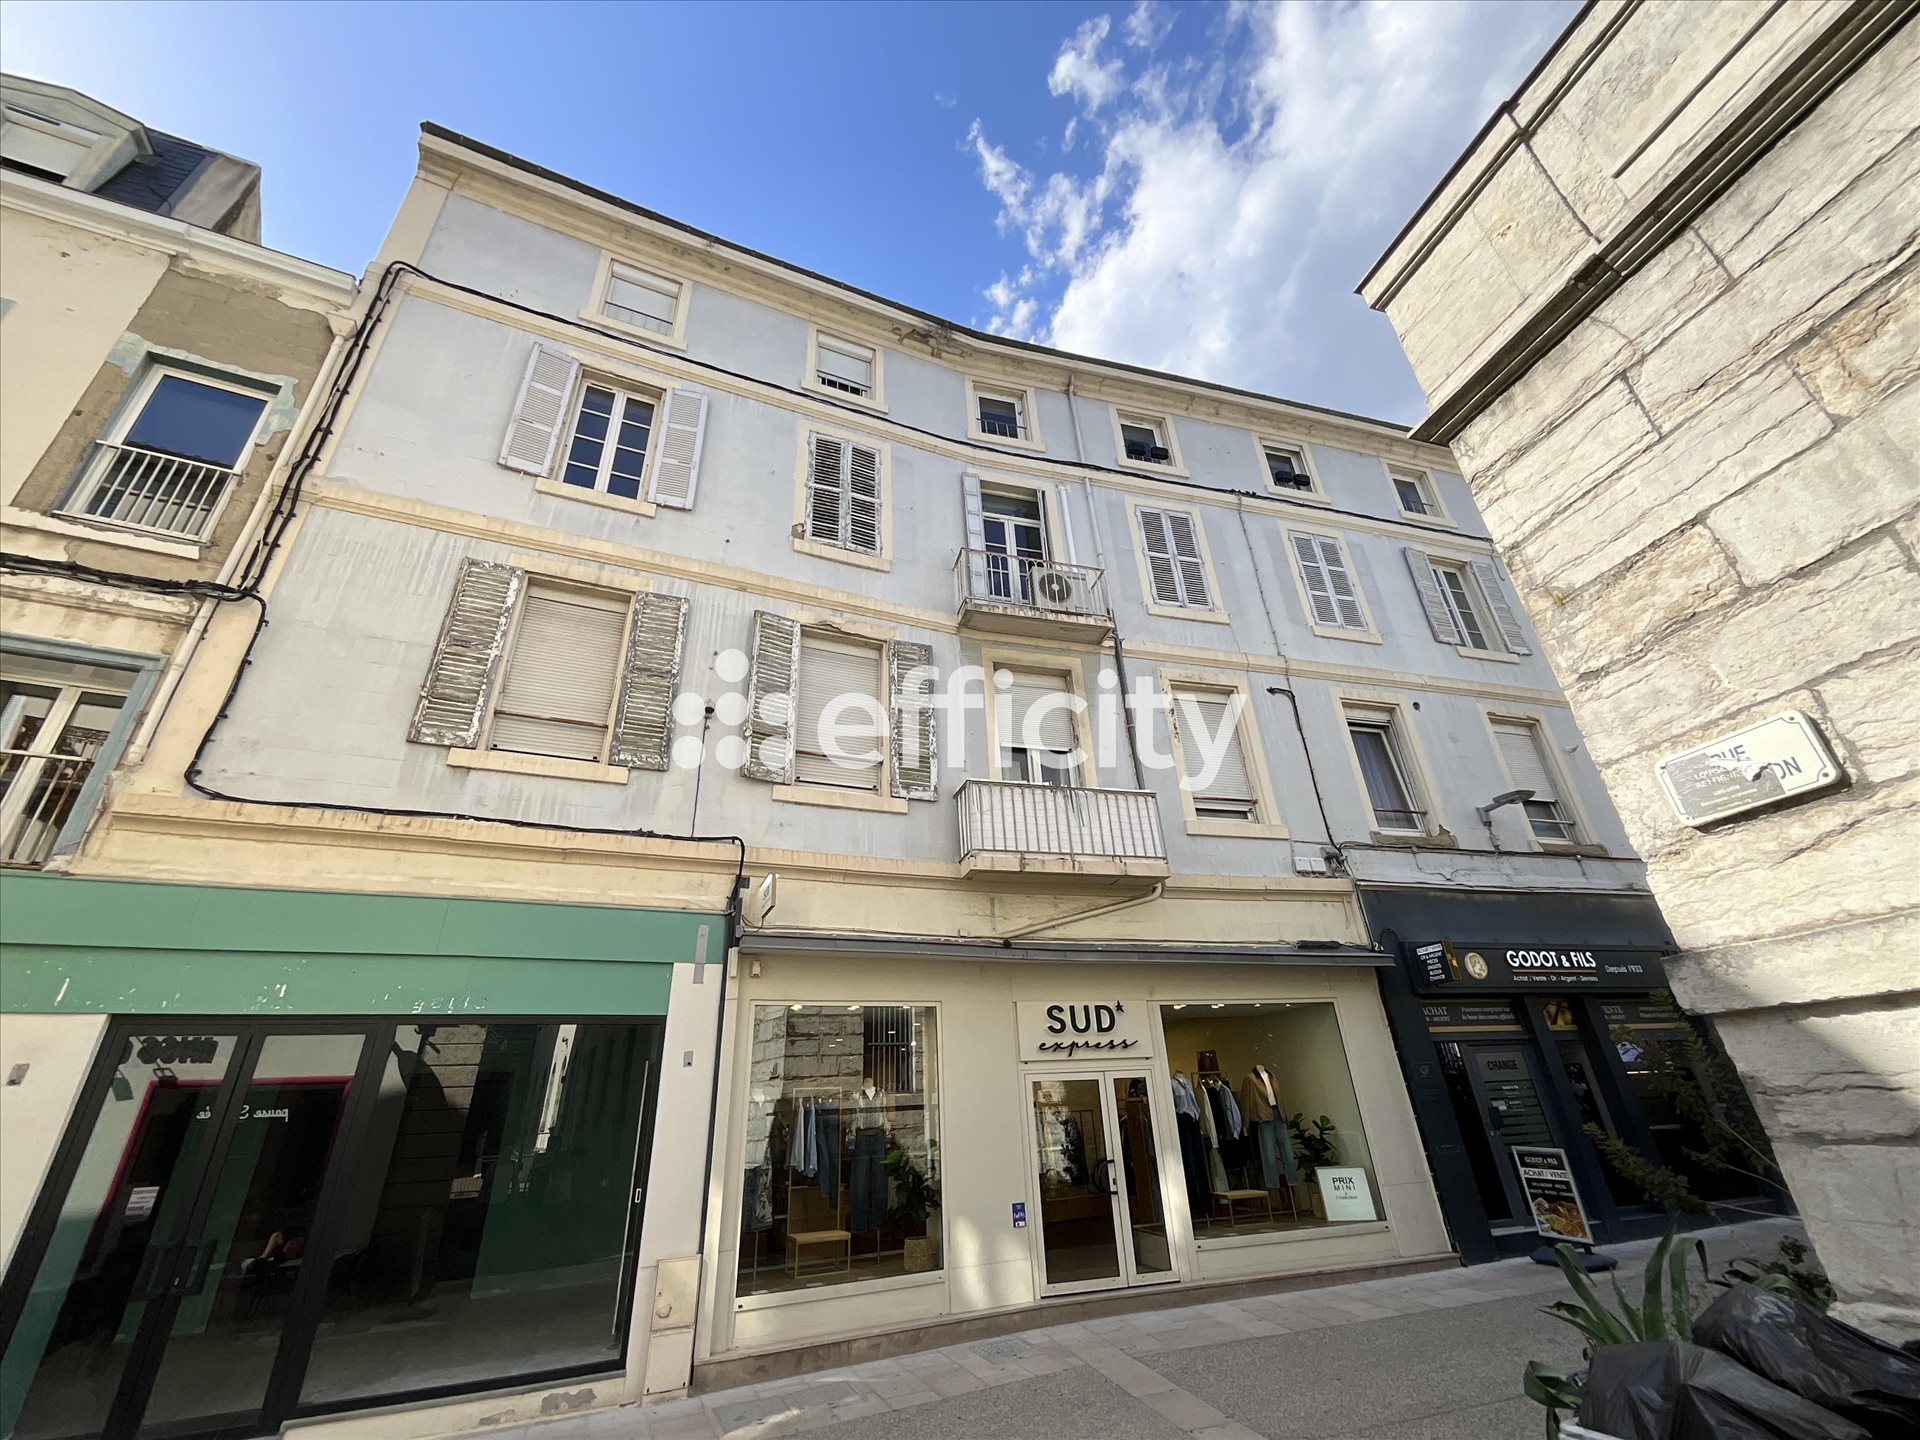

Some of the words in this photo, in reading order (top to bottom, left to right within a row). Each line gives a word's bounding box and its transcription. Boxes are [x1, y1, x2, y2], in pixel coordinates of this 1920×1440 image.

[1505, 950, 1559, 967] GODOT
[1560, 954, 1571, 967] &
[1570, 951, 1597, 967] FILS
[1604, 965, 1628, 973] Depuis
[1629, 965, 1643, 973] 1933
[1560, 975, 1577, 983] Argent
[1046, 1005, 1116, 1034] SUD
[1038, 1039, 1139, 1057] express
[1487, 1059, 1518, 1071] CHANGE
[1523, 1169, 1544, 1177] ACHAT
[1332, 1177, 1354, 1185] PRIX
